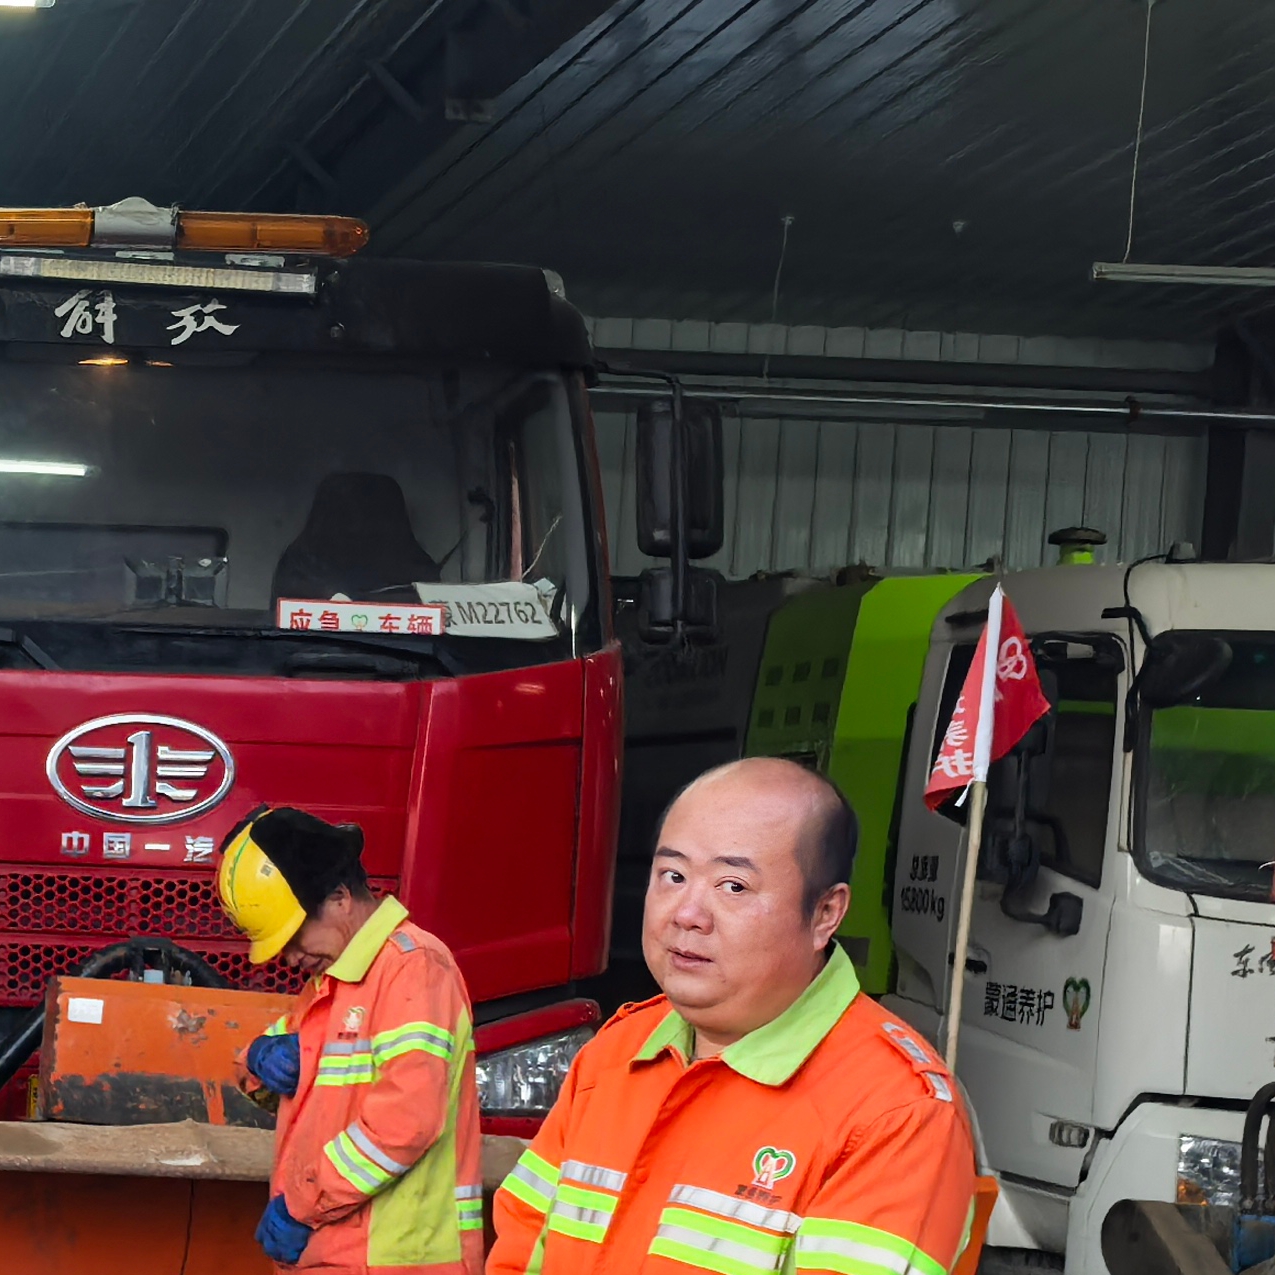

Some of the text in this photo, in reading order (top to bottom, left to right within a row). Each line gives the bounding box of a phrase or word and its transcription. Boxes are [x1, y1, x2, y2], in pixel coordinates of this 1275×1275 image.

[54, 289, 240, 345] 解放
[289, 608, 434, 635] 应急 车辆
[60, 831, 215, 864] 中国一汽
[984, 981, 1055, 1027] 蒙通养护
